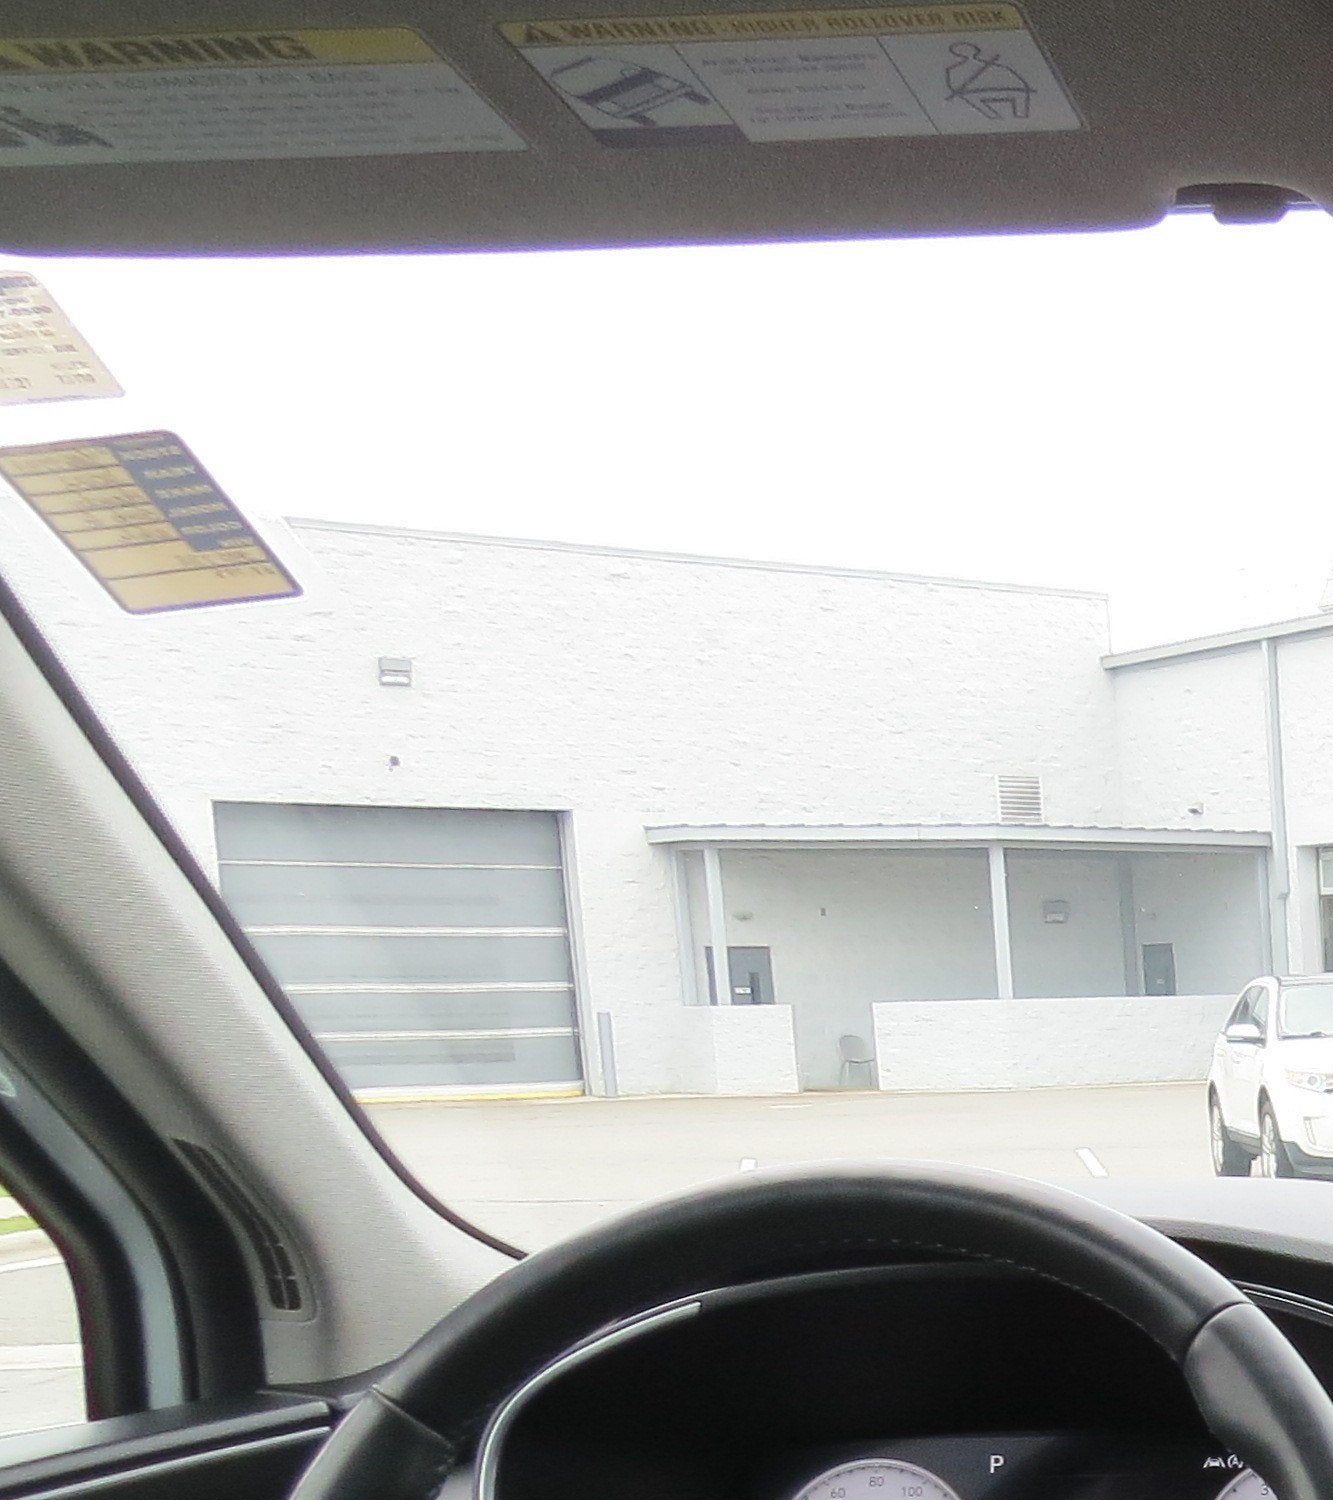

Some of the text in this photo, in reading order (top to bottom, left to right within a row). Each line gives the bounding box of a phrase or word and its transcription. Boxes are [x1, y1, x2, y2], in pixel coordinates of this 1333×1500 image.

[826, 12, 943, 31] ROLLOVER
[951, 9, 1006, 26] RISK
[17, 36, 317, 68] WARNING
[989, 1454, 1004, 1474] P
[868, 1476, 884, 1488] 80
[830, 1487, 846, 1499] 60
[901, 1486, 923, 1498] 100
